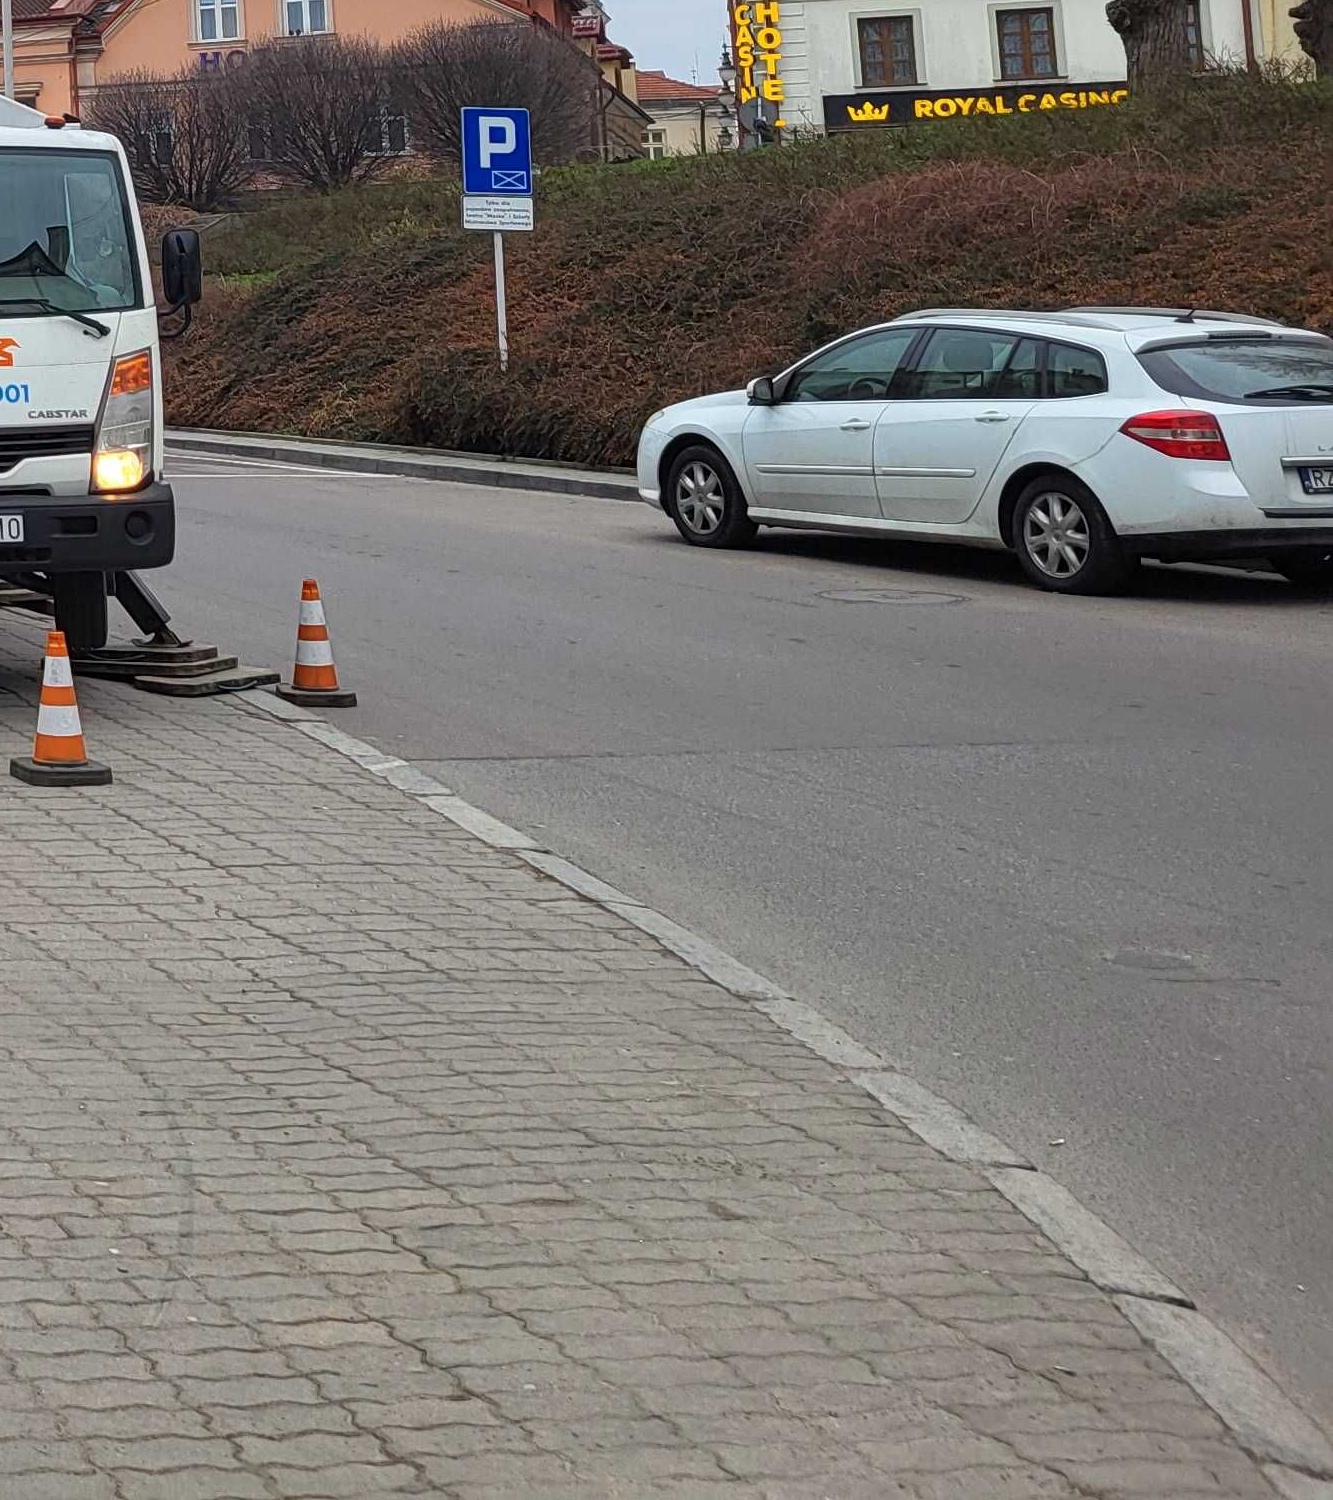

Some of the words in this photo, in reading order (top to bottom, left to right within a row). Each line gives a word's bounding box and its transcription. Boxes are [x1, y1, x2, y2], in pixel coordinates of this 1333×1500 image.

[734, 3, 757, 104] CASIN
[755, 1, 787, 128] HOTE
[913, 95, 1014, 119] ROYAL
[478, 115, 517, 169] P
[27, 409, 88, 419] CABSTAR
